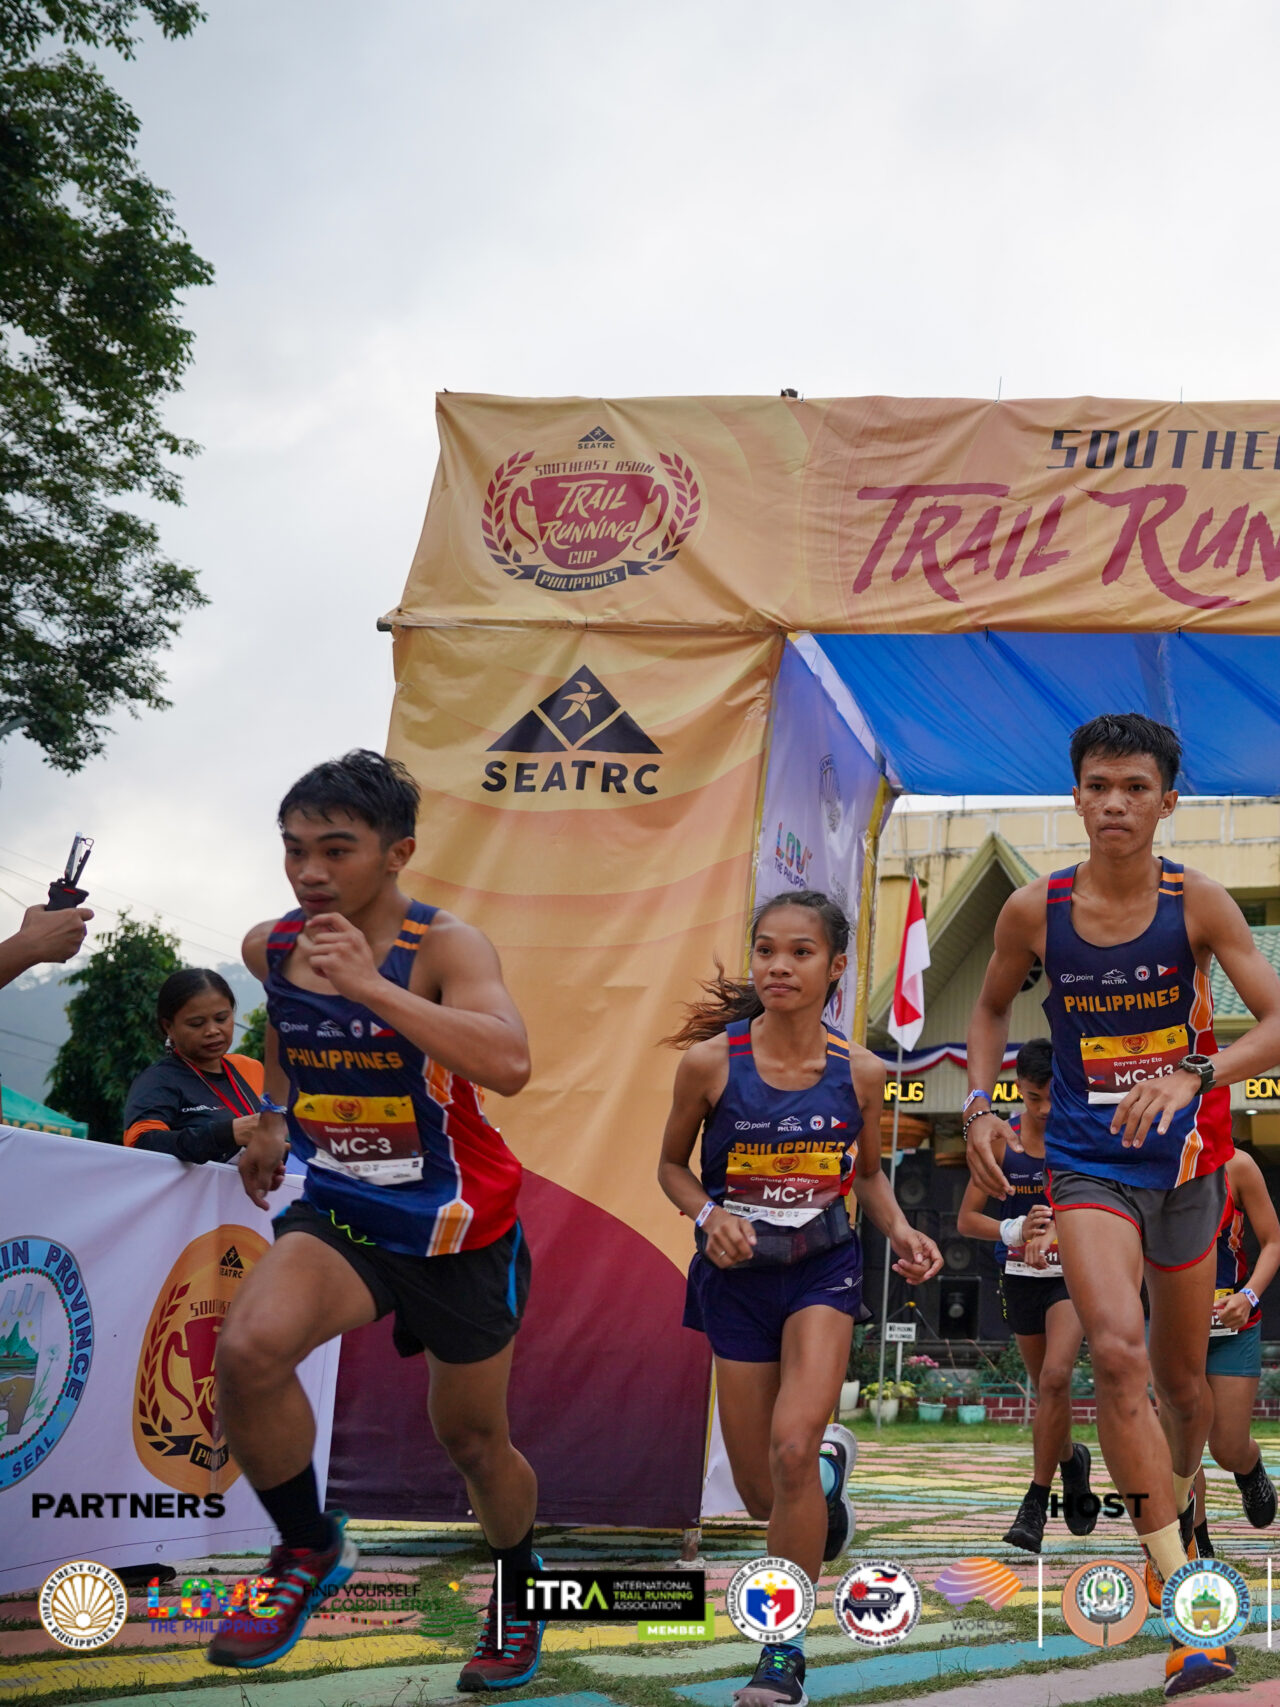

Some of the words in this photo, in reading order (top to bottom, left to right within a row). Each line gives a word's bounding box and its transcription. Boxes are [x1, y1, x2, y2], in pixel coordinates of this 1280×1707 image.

[535, 460, 610, 477] SOUTHEAST
[615, 460, 655, 474] ASIAN
[557, 479, 627, 519] TRAIL
[540, 516, 638, 549] RUNNING
[852, 482, 1072, 602] TRAIL
[567, 550, 598, 565] CUP
[539, 570, 619, 590] PHILIPPINES
[481, 760, 659, 796] SEATRC
[1076, 974, 1093, 982] point
[1063, 985, 1180, 1013] PHILIPPINES
[287, 1048, 403, 1070] PHILIPPINES
[1115, 1064, 1174, 1086] MC-13
[751, 1121, 771, 1129] point
[330, 1137, 392, 1155] MC-3
[763, 1185, 814, 1202] MC-1
[44, 1244, 92, 1401] PROVINCE
[12, 1435, 55, 1478] SEAL
